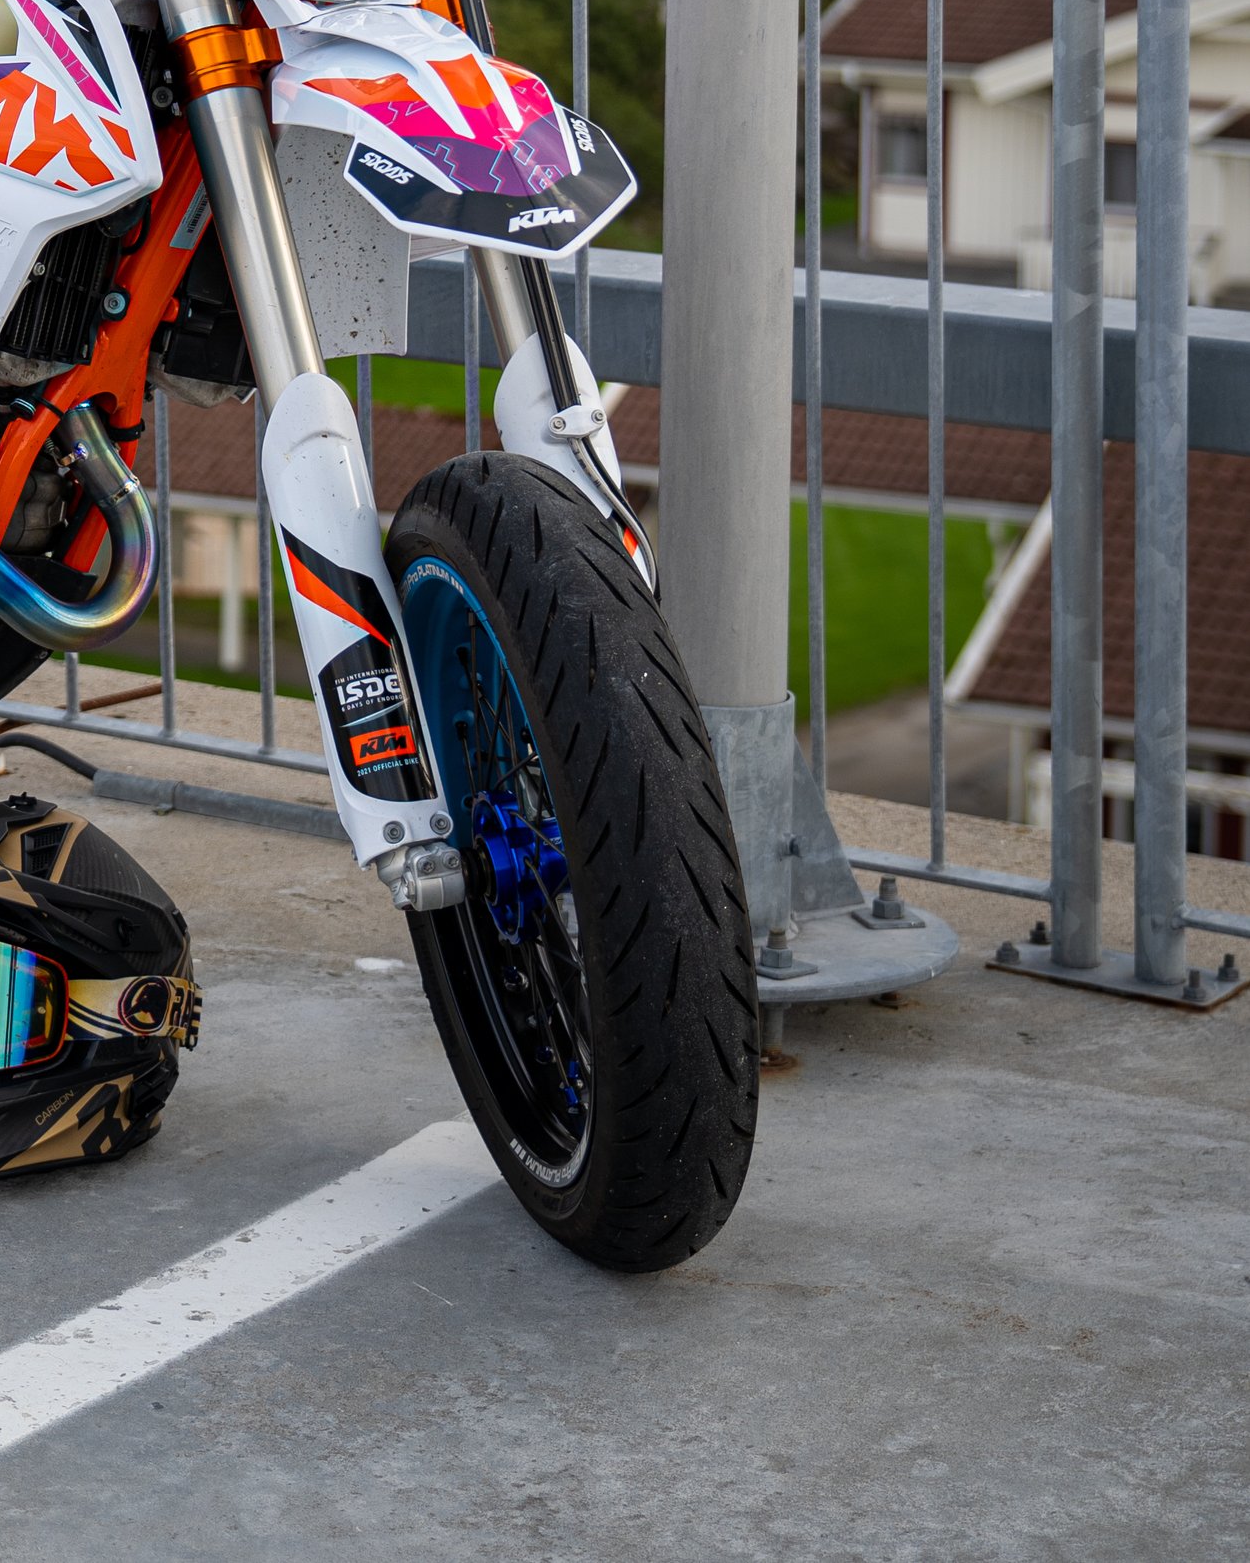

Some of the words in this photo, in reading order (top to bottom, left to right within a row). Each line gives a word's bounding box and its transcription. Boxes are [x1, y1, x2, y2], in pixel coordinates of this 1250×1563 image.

[358, 151, 415, 185] SIXDAYS
[509, 207, 576, 233] KTM
[346, 667, 398, 681] INTERNATIONAL
[336, 674, 401, 706] ISDE
[347, 702, 364, 711] DAYS
[365, 698, 375, 706] OF
[359, 733, 408, 759] KTM
[356, 767, 372, 778] 2021
[372, 760, 404, 773] OFFICIAL
[404, 757, 420, 766] BIKE
[35, 1090, 75, 1127] CARBON
